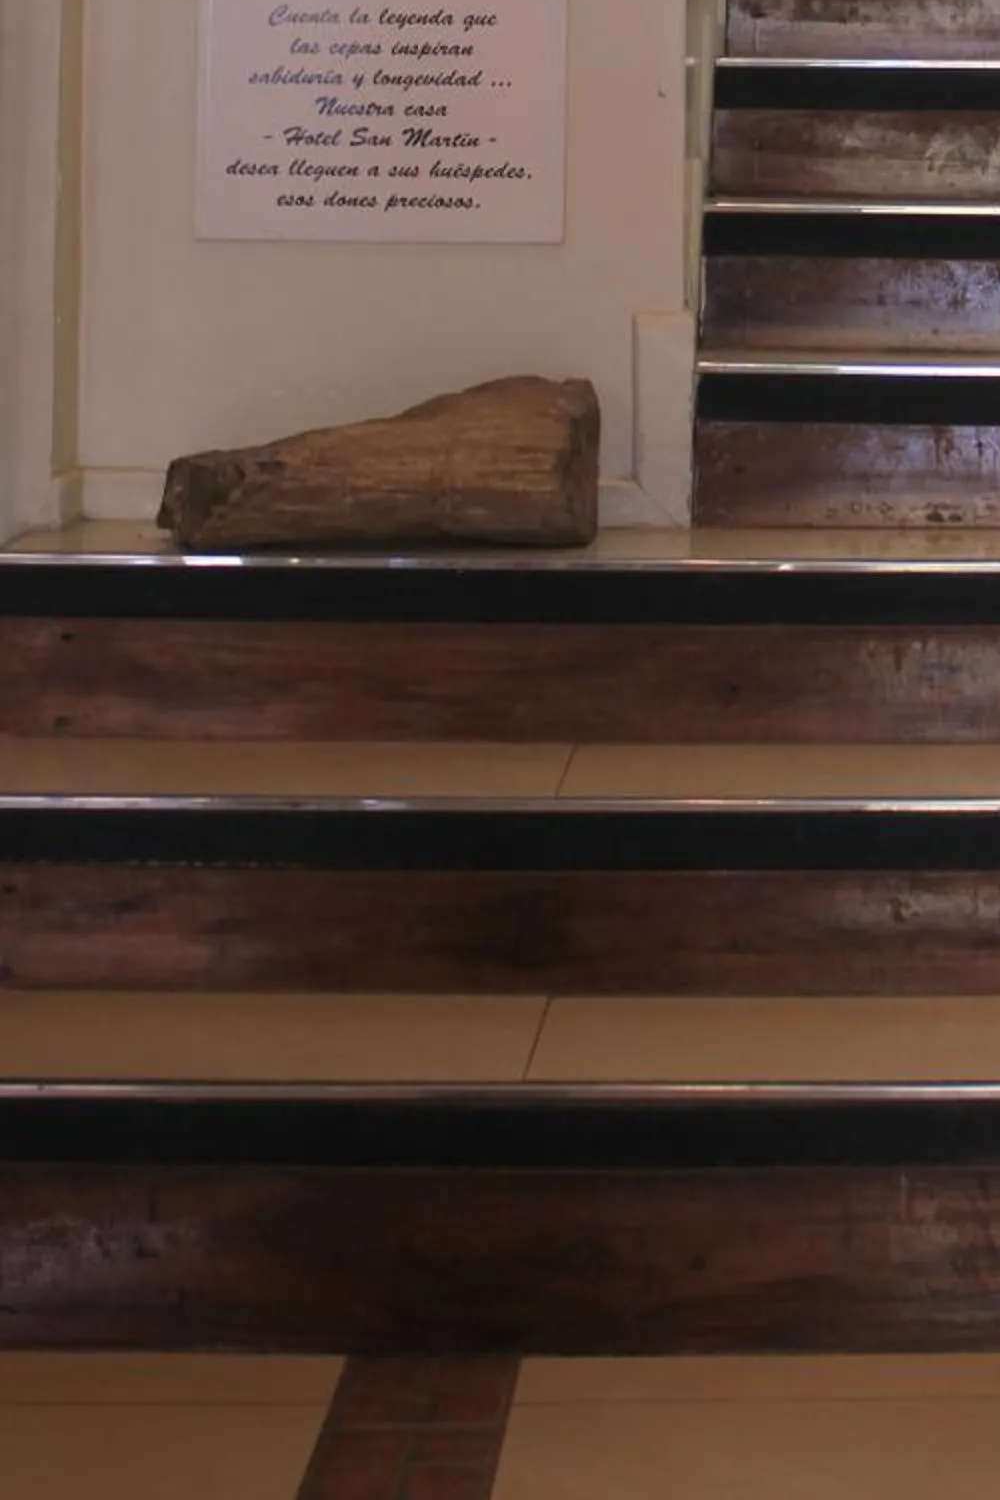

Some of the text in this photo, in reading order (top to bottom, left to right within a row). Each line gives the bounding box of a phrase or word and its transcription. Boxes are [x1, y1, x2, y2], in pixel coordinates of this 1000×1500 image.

[269, 4, 497, 32] Cuenta la leyenda que
[290, 37, 474, 60] las cepas inspiran
[352, 74, 364, 90] y
[373, 69, 483, 92] longevidad
[315, 96, 448, 117] Nuestra casa
[283, 126, 341, 146] Hotel
[349, 127, 391, 146] San
[402, 128, 480, 148] Martín
[226, 159, 279, 176] desea
[289, 159, 359, 181] lleguen
[367, 166, 380, 178] a
[388, 166, 420, 178] sus
[277, 191, 480, 212] esos dones preciosos.
